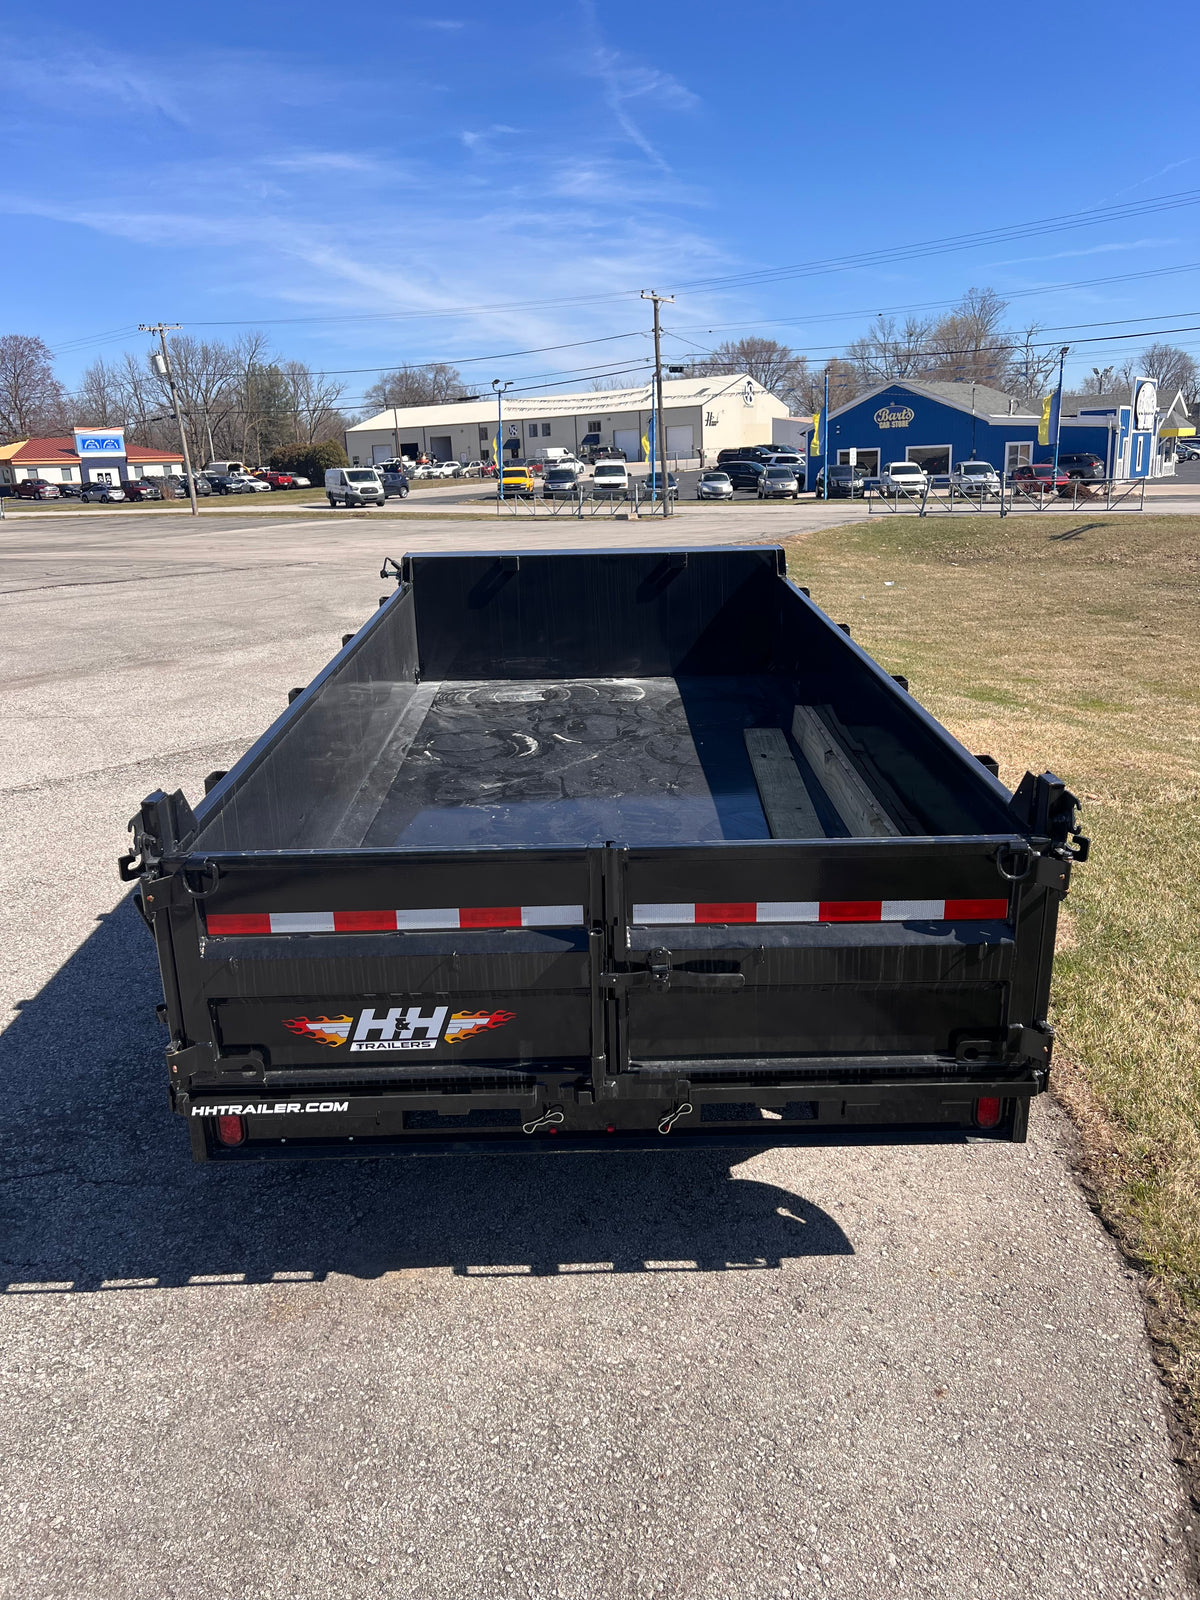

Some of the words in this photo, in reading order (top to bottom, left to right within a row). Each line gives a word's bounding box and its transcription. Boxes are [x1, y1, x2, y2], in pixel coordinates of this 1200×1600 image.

[877, 408, 911, 421] Bart's
[891, 420, 909, 428] STORE
[353, 1006, 449, 1041] H&H
[356, 1041, 431, 1050] TRAILERS
[191, 1102, 349, 1116] HHTRAILER.COM
